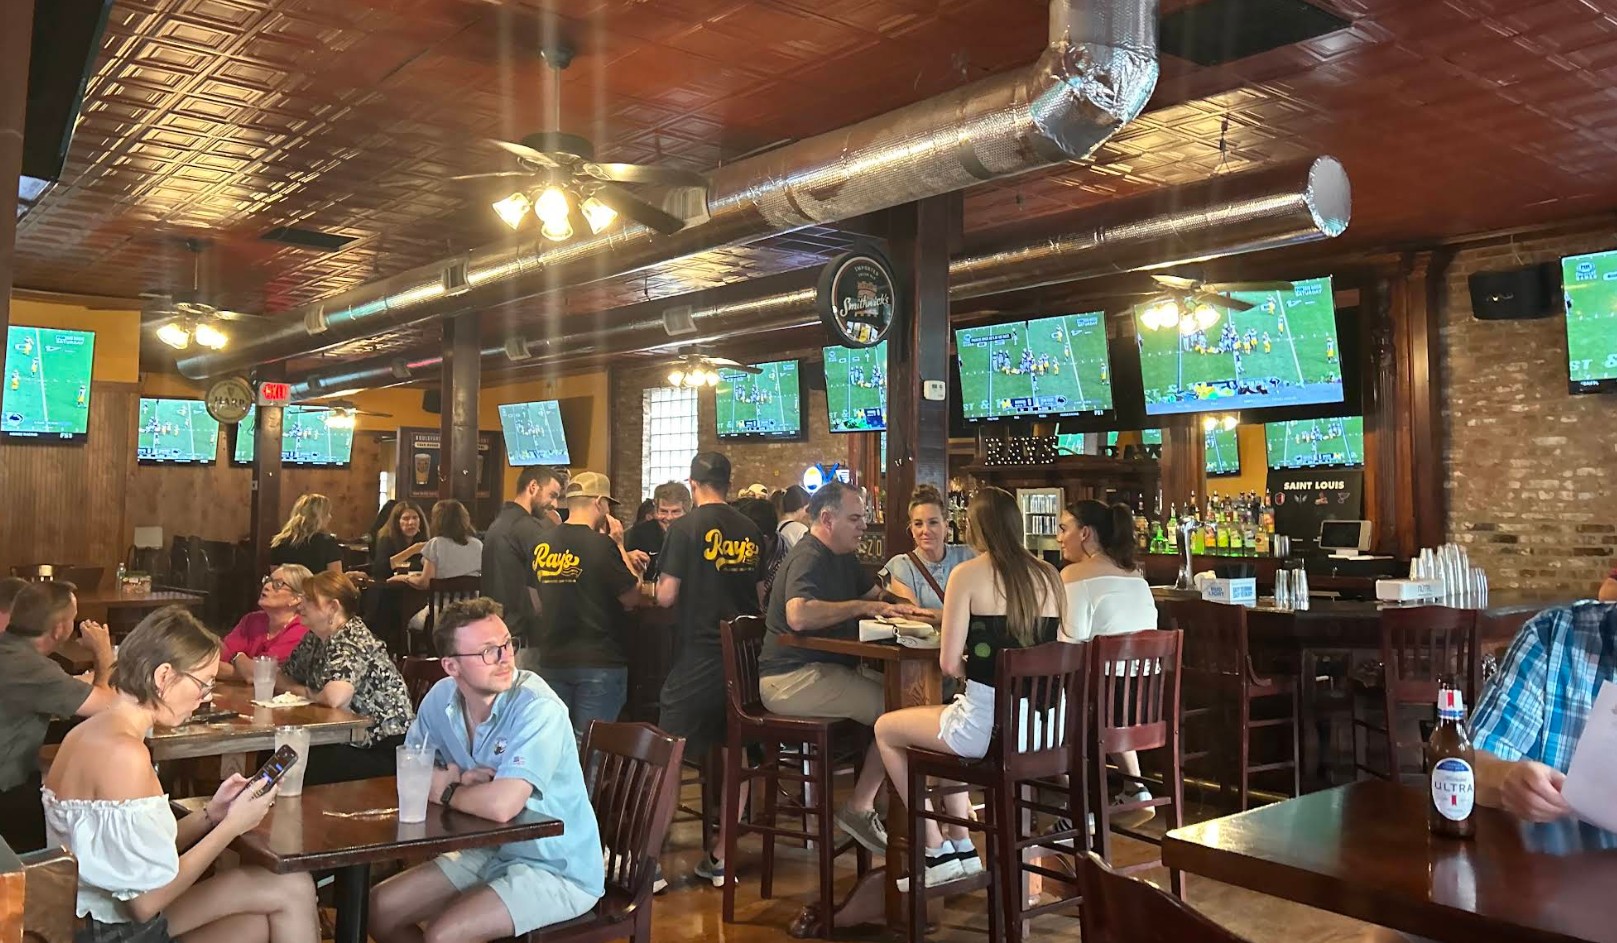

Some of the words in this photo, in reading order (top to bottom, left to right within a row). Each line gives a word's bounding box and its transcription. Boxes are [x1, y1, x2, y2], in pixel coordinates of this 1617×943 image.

[839, 293, 889, 317] Smithwick's
[215, 396, 246, 408] HARP
[984, 436, 1057, 467] RAYS
[1284, 482, 1312, 490] SAINT
[1315, 481, 1345, 490] LOUIS
[703, 528, 759, 571] Ray's
[532, 542, 580, 583] Ray's
[1434, 780, 1473, 793] ULTRA
